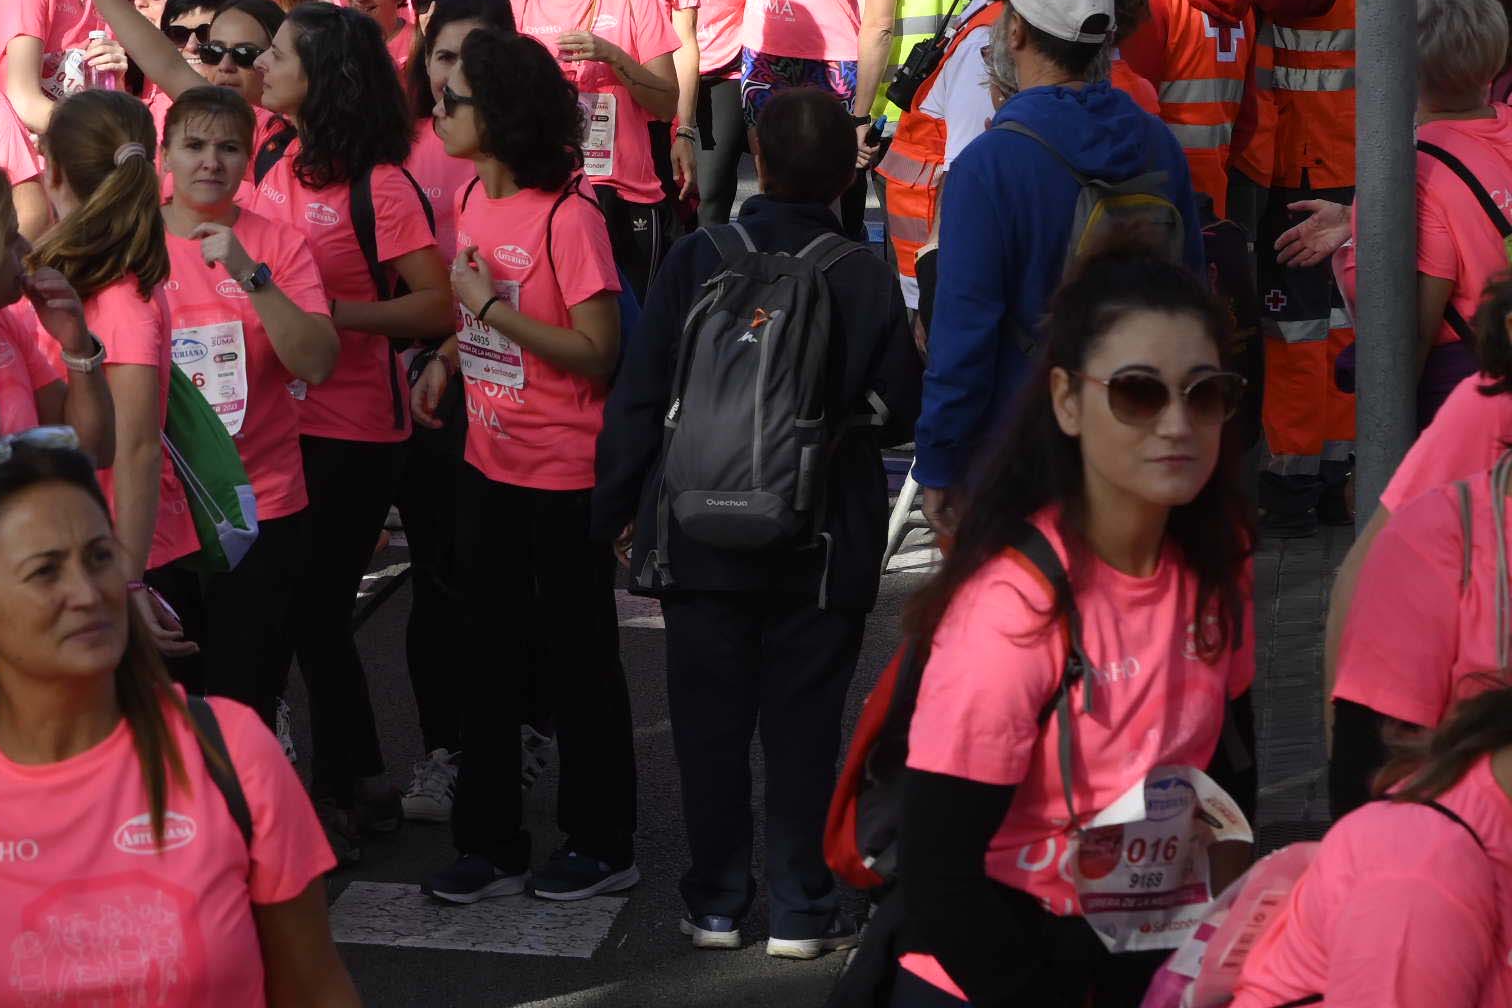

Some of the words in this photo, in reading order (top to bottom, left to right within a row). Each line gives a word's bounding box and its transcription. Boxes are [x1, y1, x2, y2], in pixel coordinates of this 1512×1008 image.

[497, 253, 529, 266] ASTURIANA
[192, 372, 206, 388] 6
[706, 498, 749, 507] Quechua
[1127, 835, 1179, 864] 016
